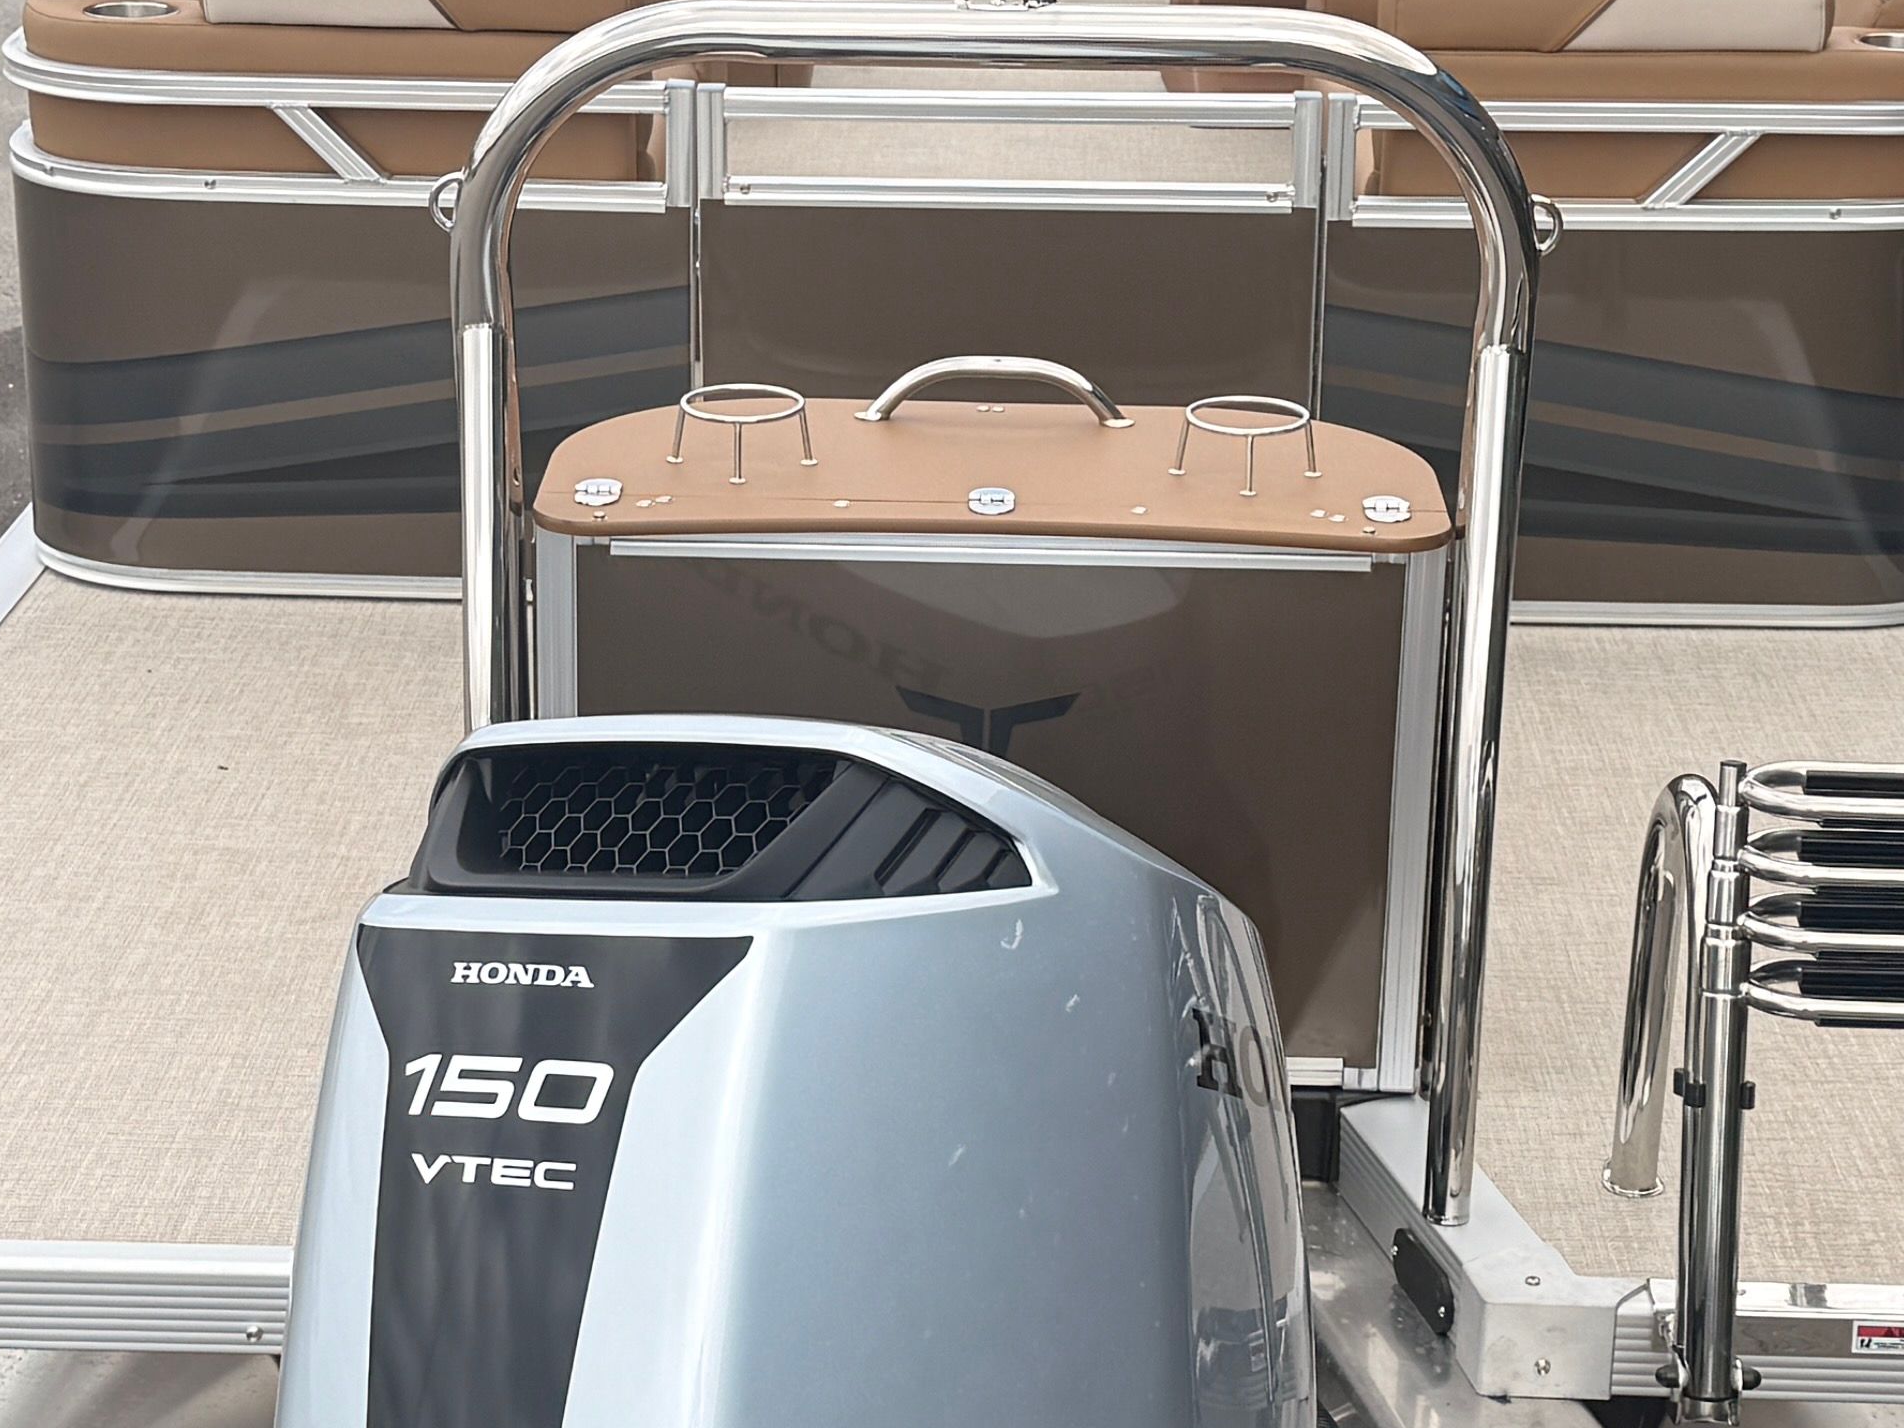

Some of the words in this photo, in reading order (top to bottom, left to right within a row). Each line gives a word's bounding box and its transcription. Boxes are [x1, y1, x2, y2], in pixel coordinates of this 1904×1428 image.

[450, 961, 595, 989] HONDA
[405, 1053, 615, 1125] 150
[411, 1153, 577, 1191] VTEC
